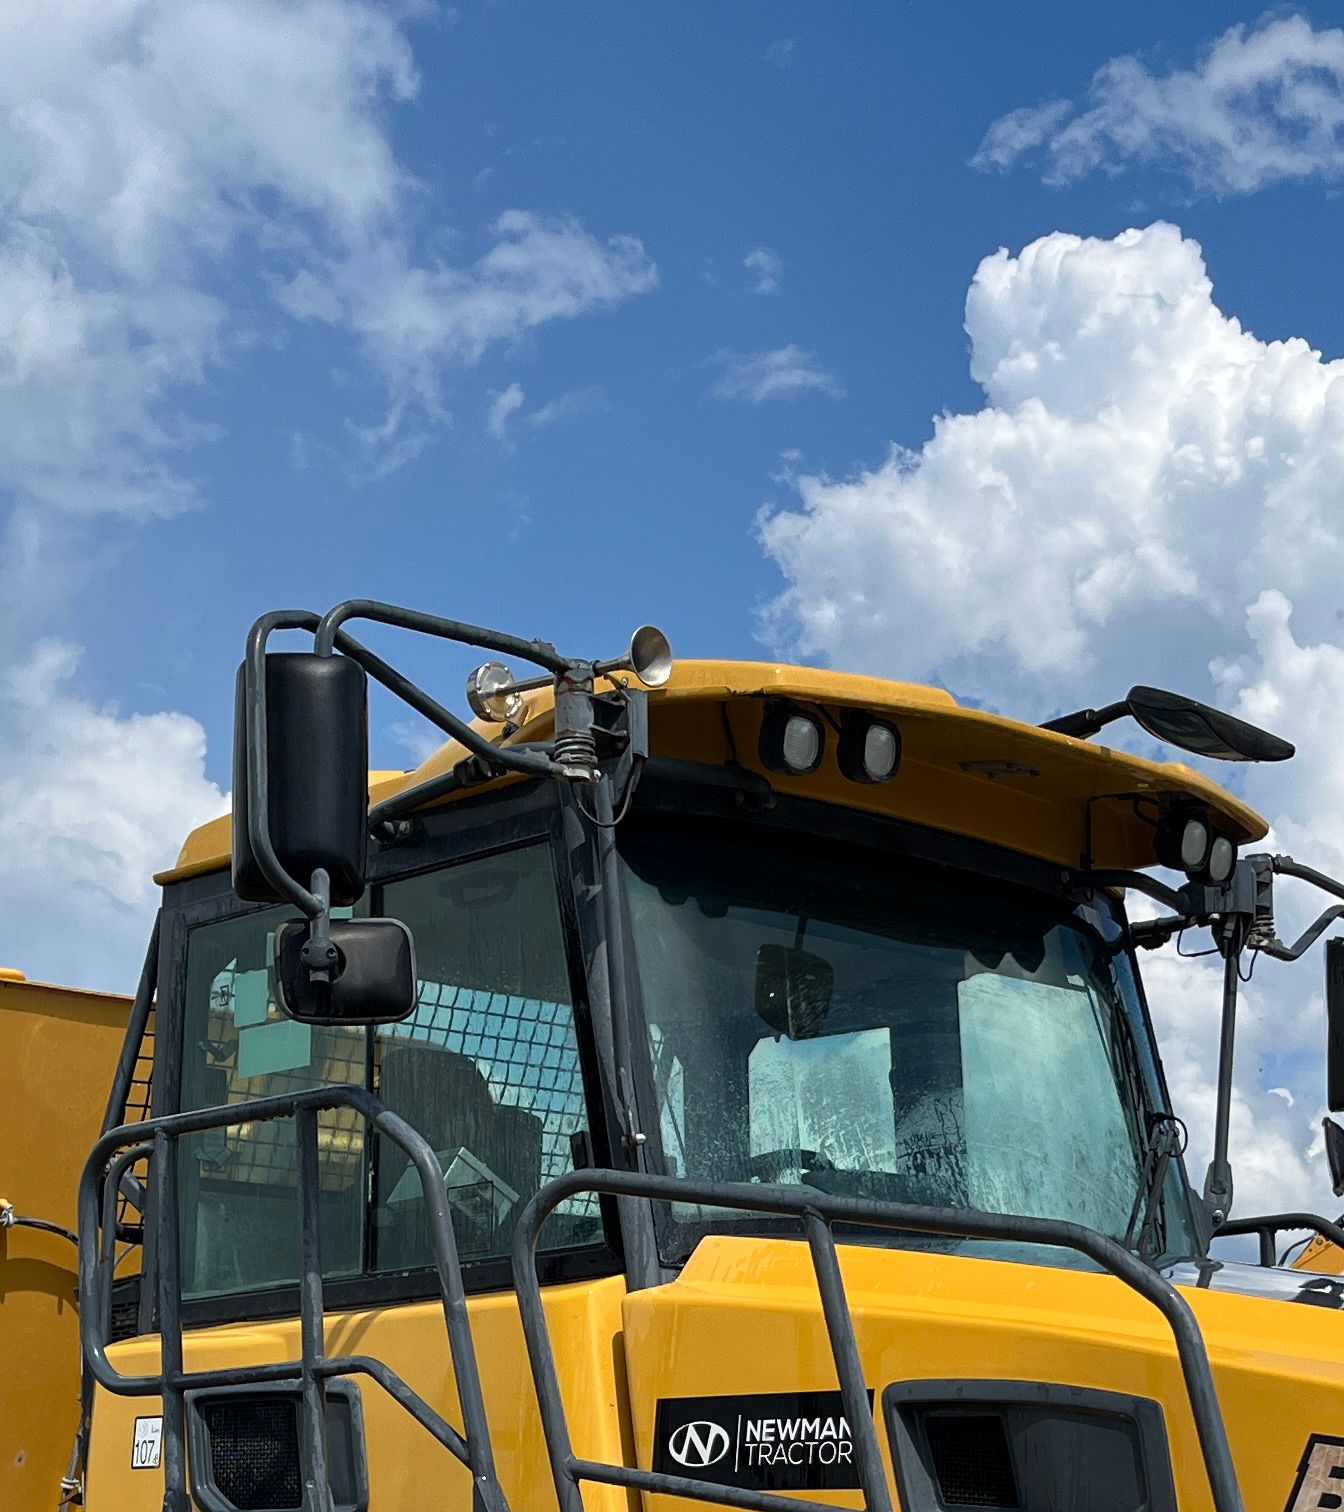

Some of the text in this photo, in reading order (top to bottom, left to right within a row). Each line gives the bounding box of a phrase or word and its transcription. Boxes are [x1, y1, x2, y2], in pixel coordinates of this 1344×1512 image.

[745, 1416, 852, 1442] NEWMAN
[135, 1439, 156, 1465] 107
[744, 1441, 853, 1466] TRACTOR
